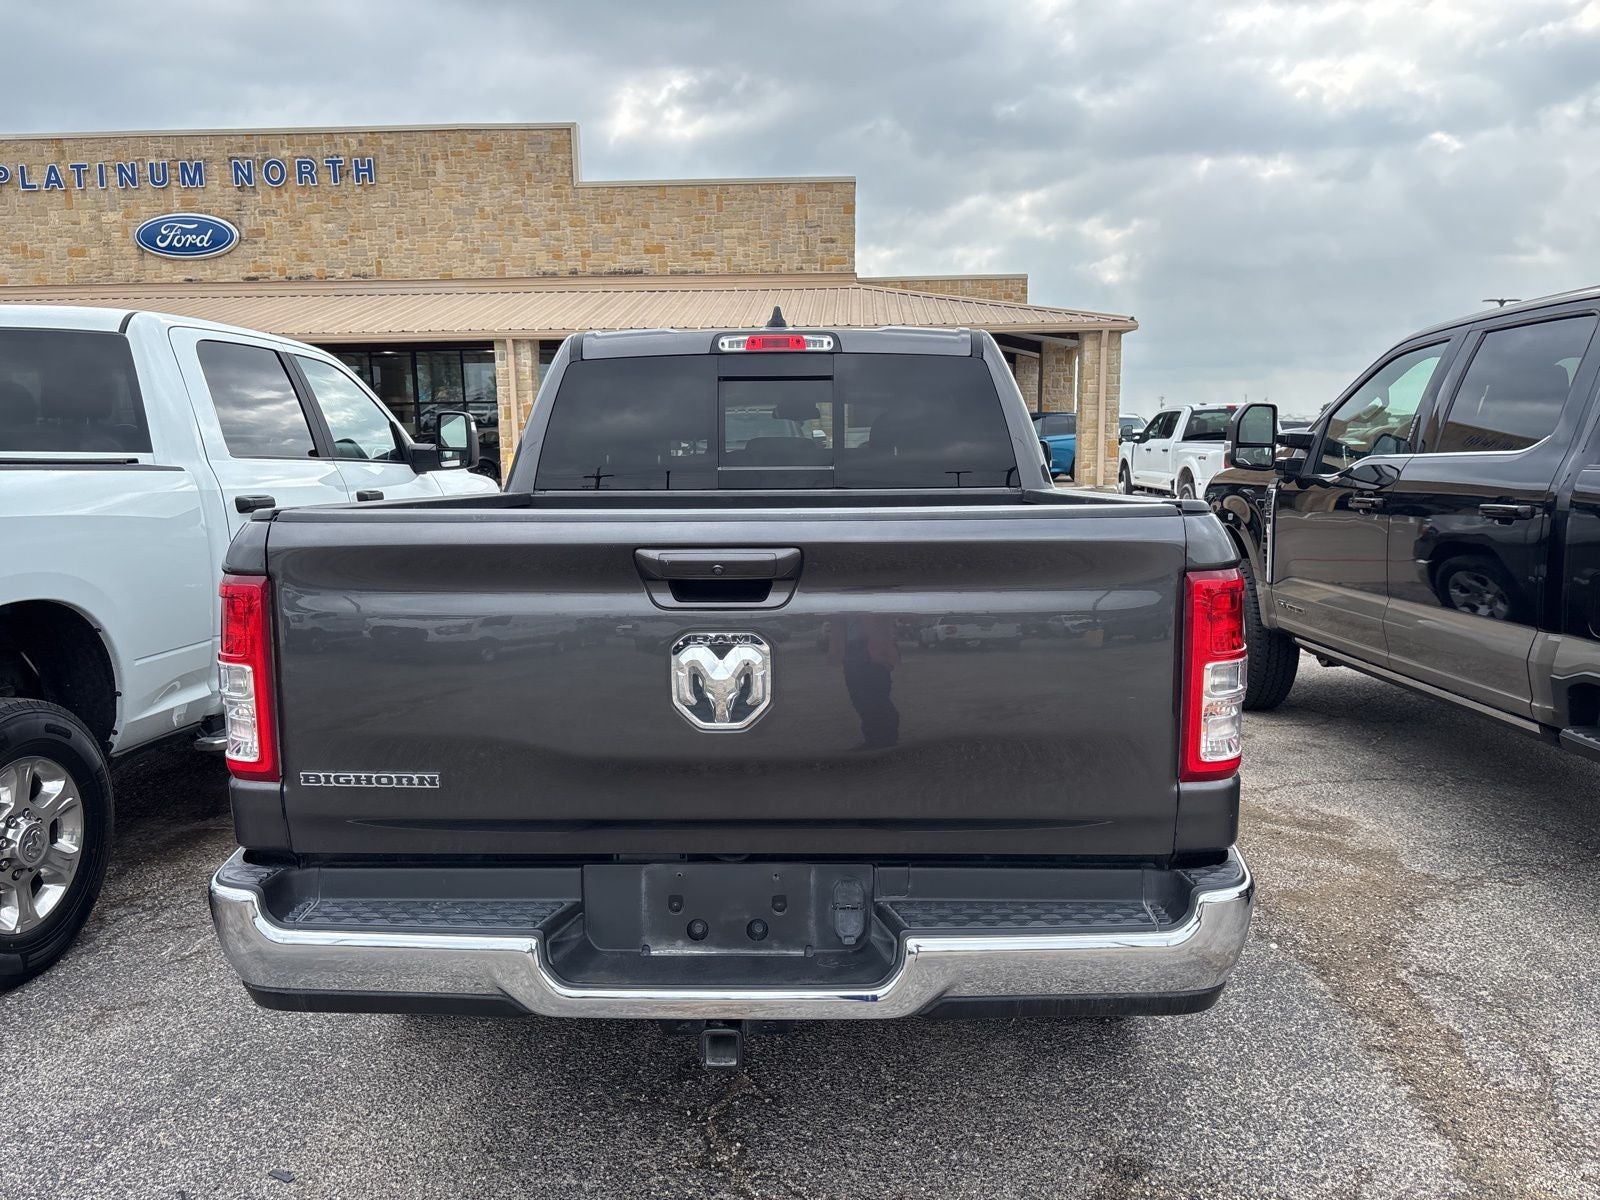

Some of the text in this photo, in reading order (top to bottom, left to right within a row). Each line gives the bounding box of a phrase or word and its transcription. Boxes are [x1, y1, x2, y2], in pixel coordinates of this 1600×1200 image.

[232, 157, 375, 187] NORTH
[156, 223, 213, 248] Ford
[690, 633, 751, 644] RAM
[300, 771, 439, 788] BIGHORN
